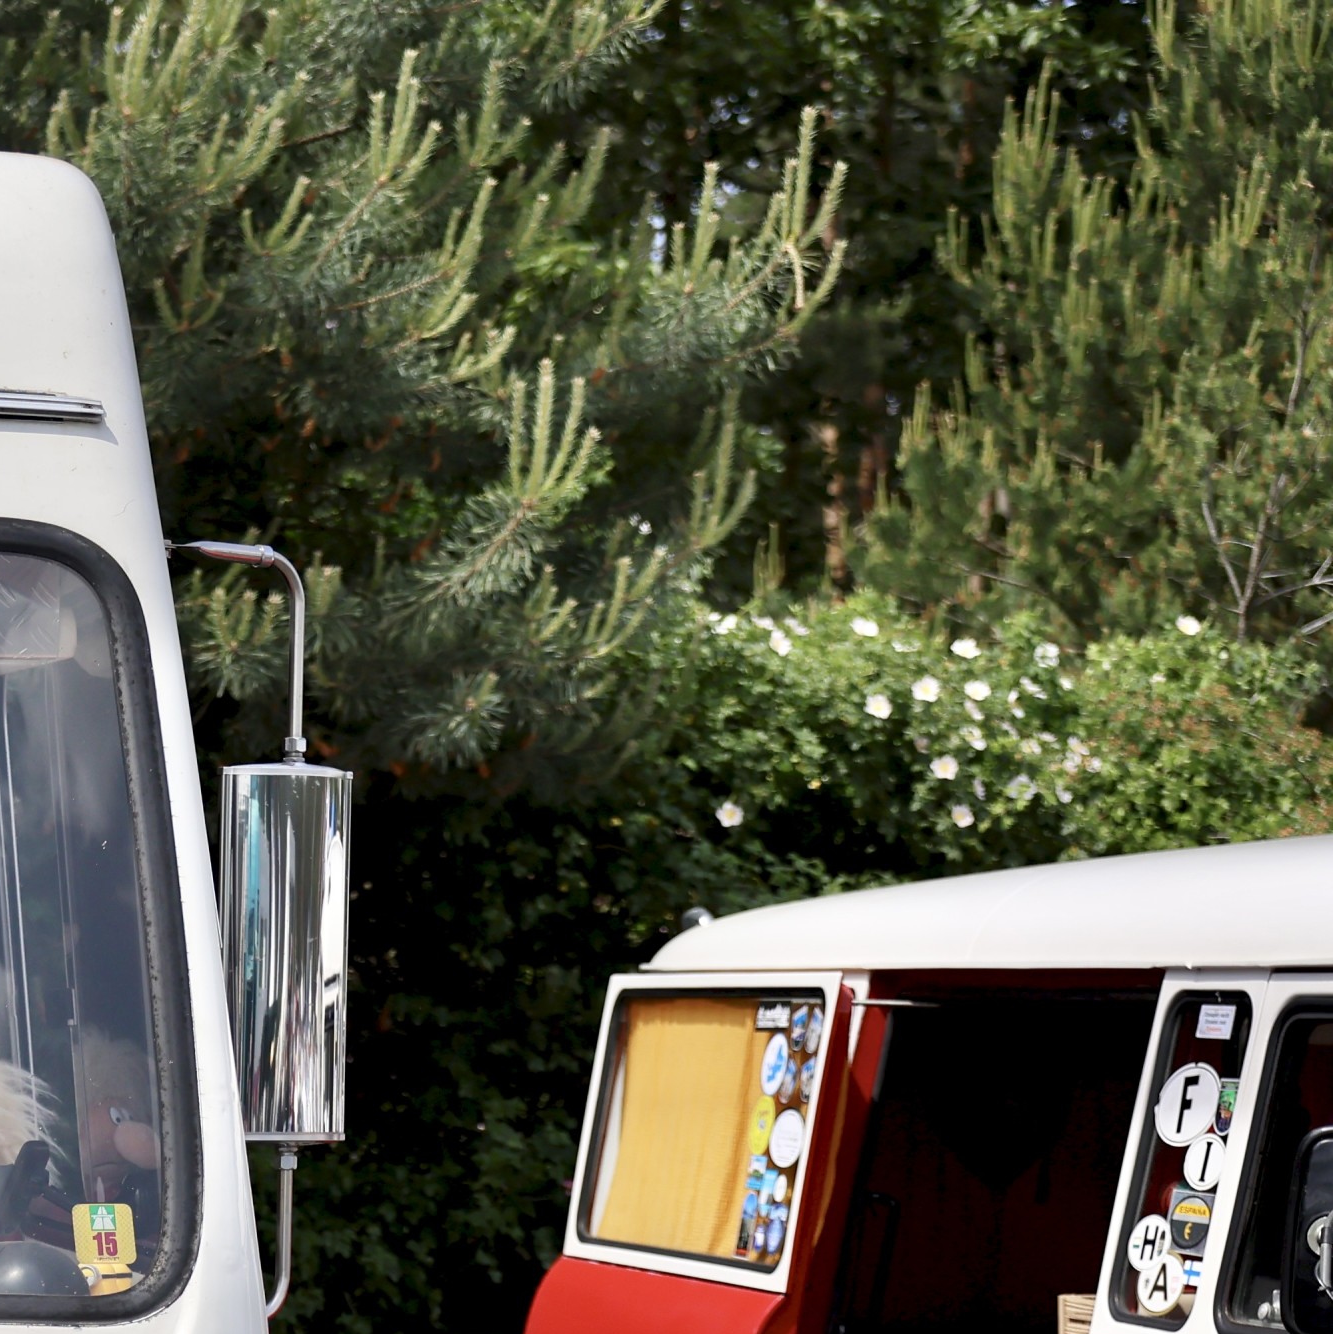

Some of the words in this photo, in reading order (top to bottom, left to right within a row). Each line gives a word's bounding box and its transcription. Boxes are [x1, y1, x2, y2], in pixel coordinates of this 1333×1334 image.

[1176, 1073, 1200, 1134] F
[1198, 1141, 1213, 1183] I
[92, 1231, 118, 1257] 15
[1140, 1225, 1159, 1261] H
[1148, 1263, 1168, 1301] A
